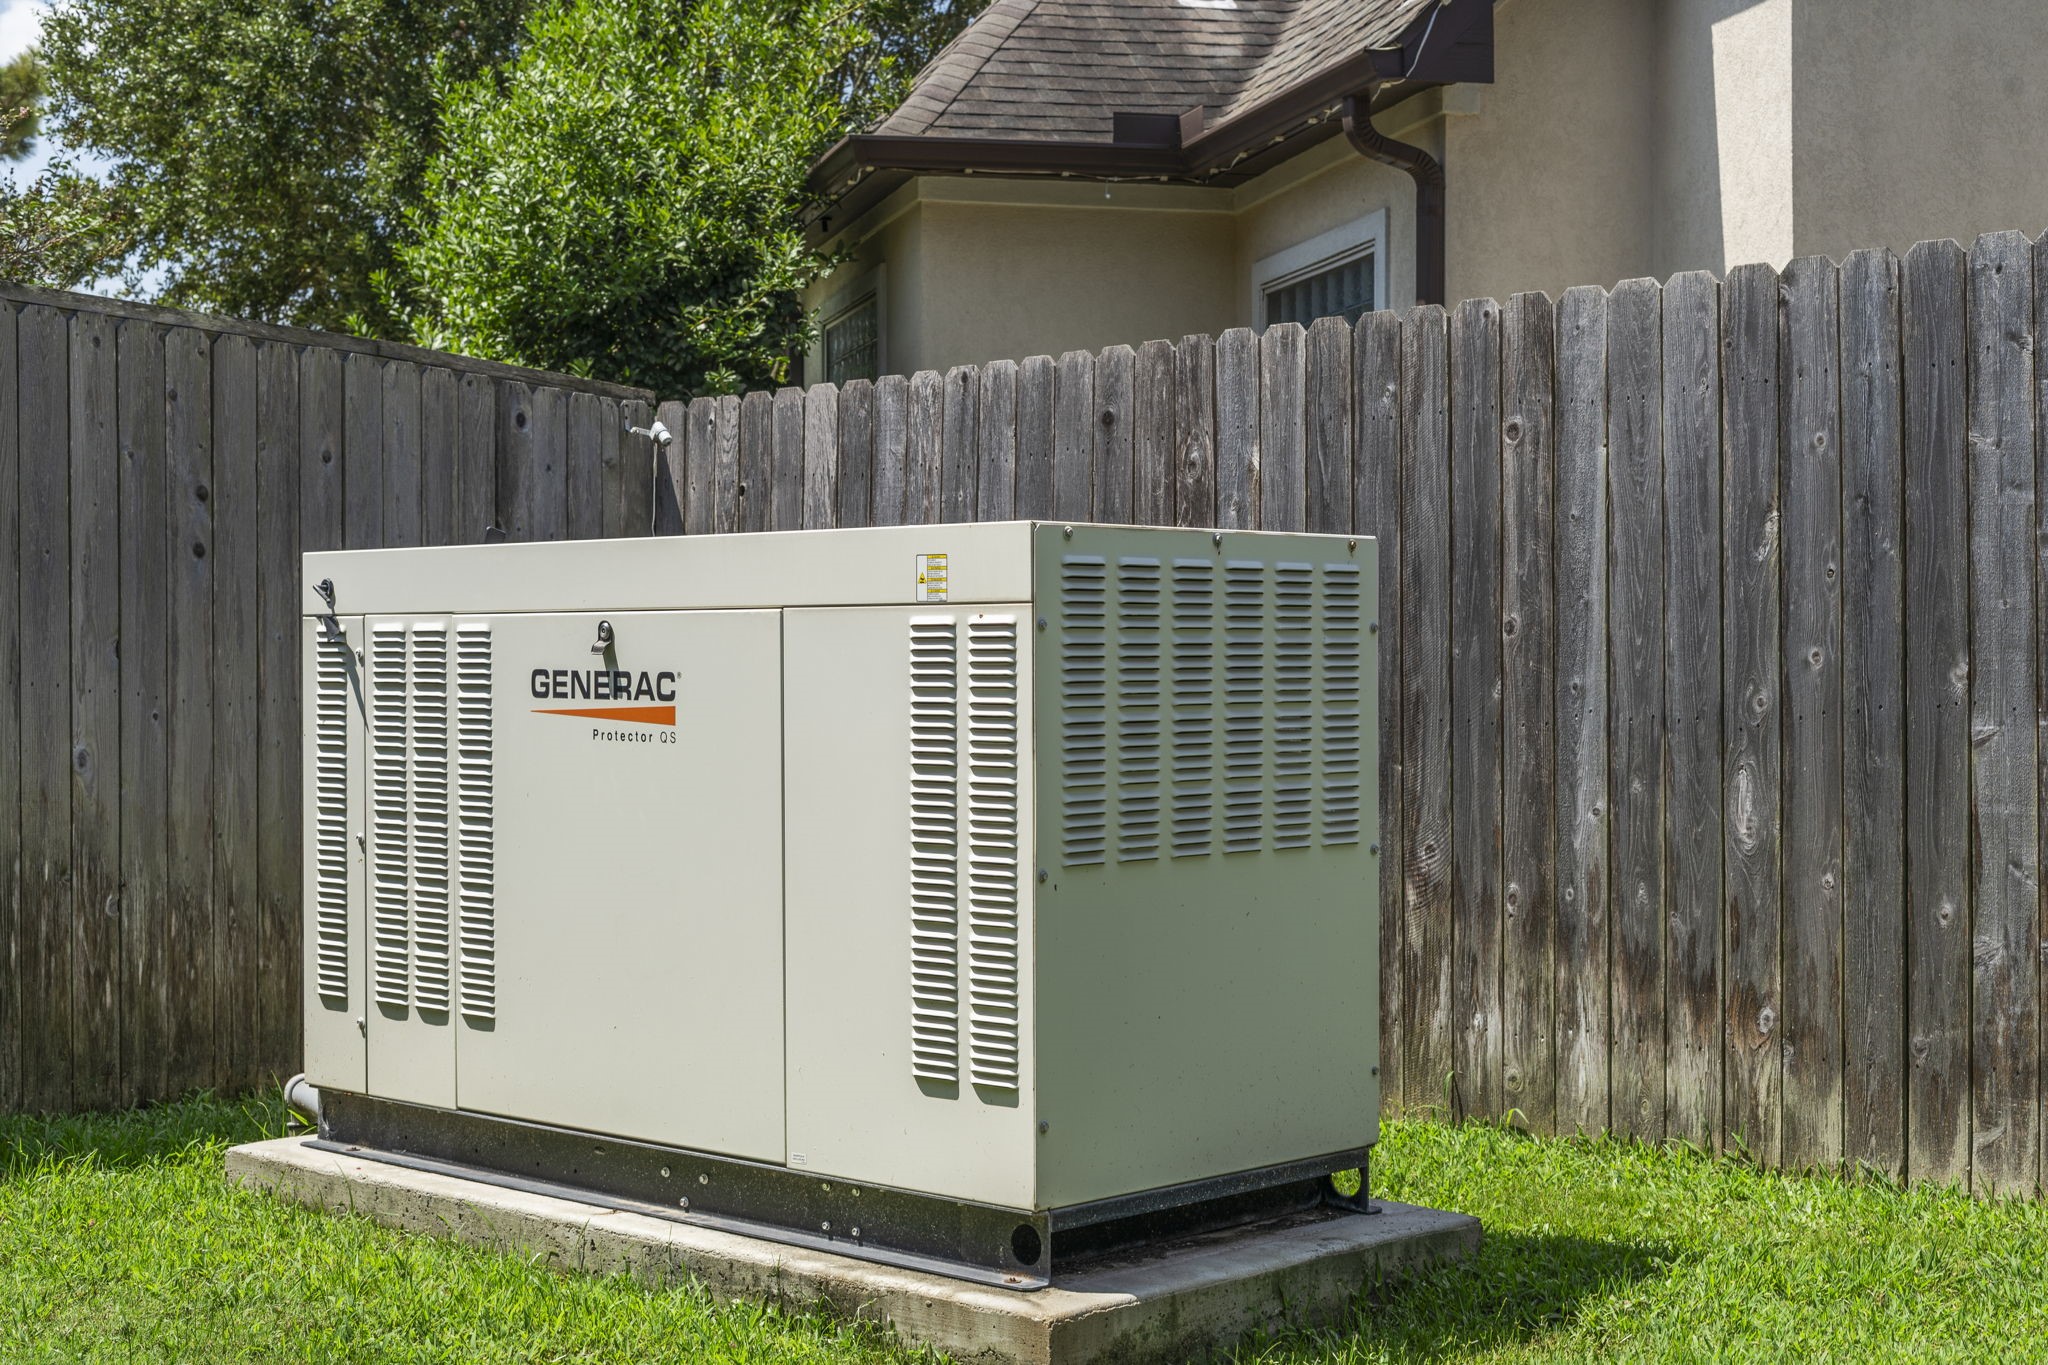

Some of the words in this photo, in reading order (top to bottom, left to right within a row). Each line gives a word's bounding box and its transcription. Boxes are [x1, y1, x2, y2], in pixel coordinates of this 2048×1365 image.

[531, 669, 677, 702] GENERAC
[592, 728, 653, 743] Protector
[659, 731, 677, 744] QS
